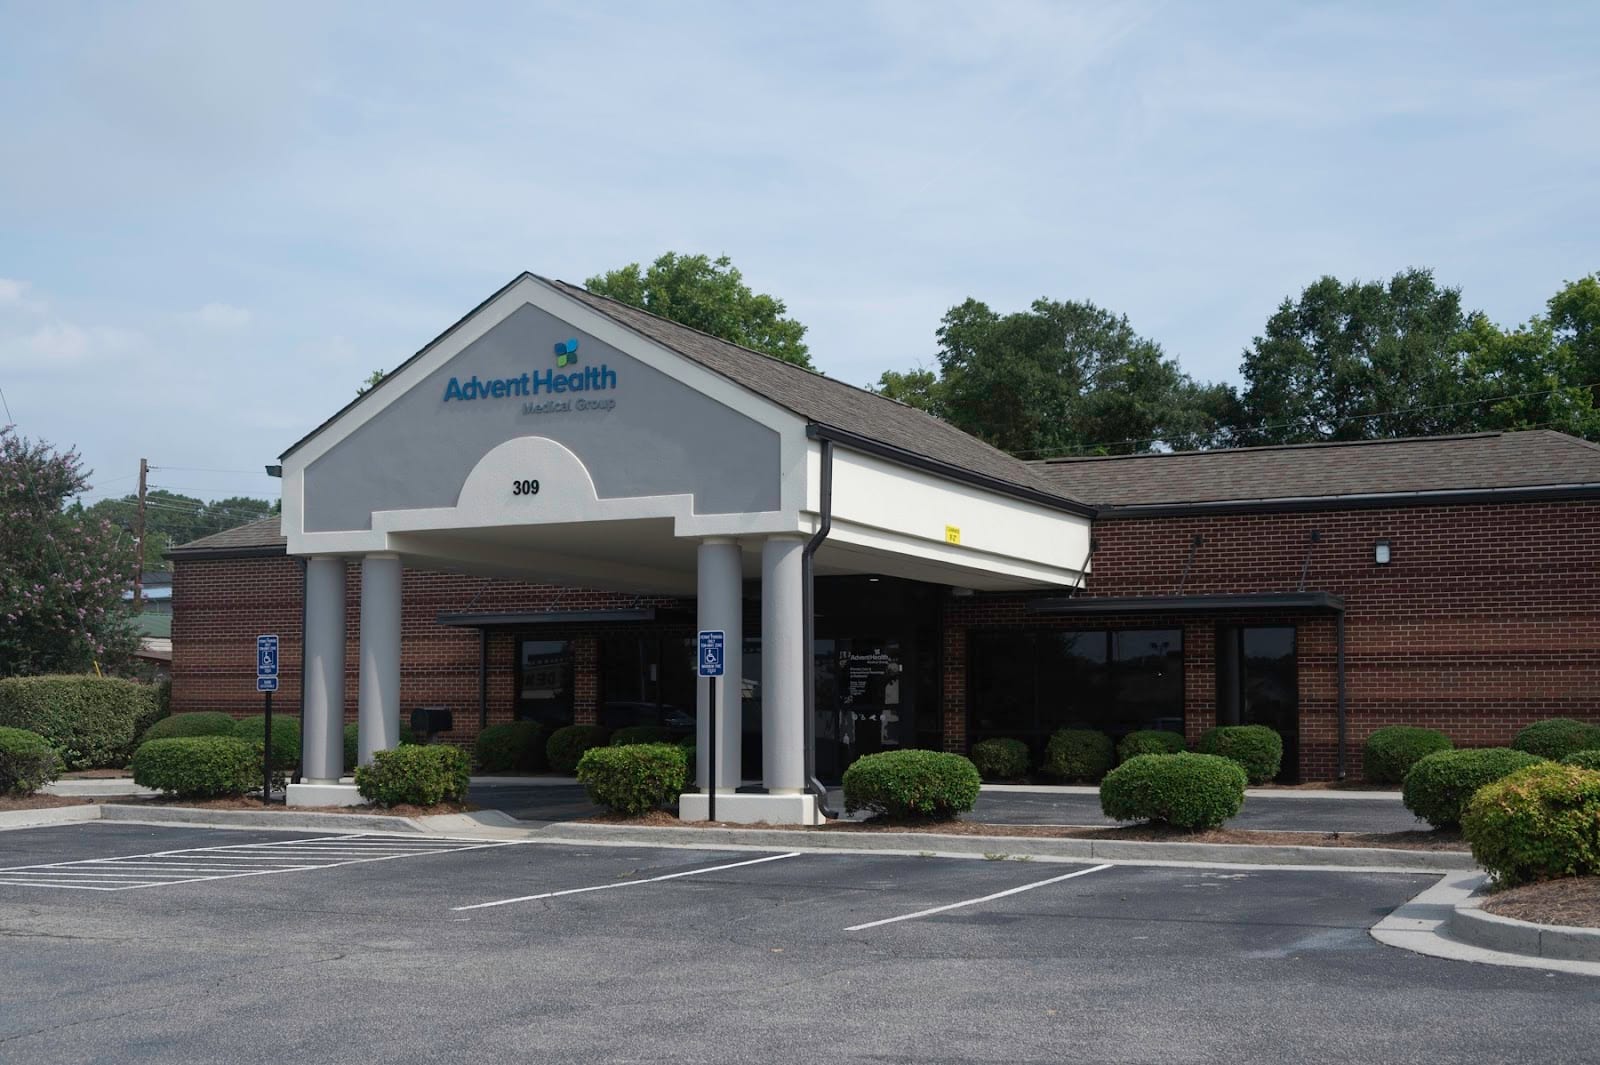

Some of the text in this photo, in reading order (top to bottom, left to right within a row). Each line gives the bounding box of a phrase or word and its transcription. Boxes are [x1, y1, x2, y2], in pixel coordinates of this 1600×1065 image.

[443, 364, 617, 402] AdventHealth
[522, 398, 616, 416] Medical Group
[513, 479, 540, 496] 309
